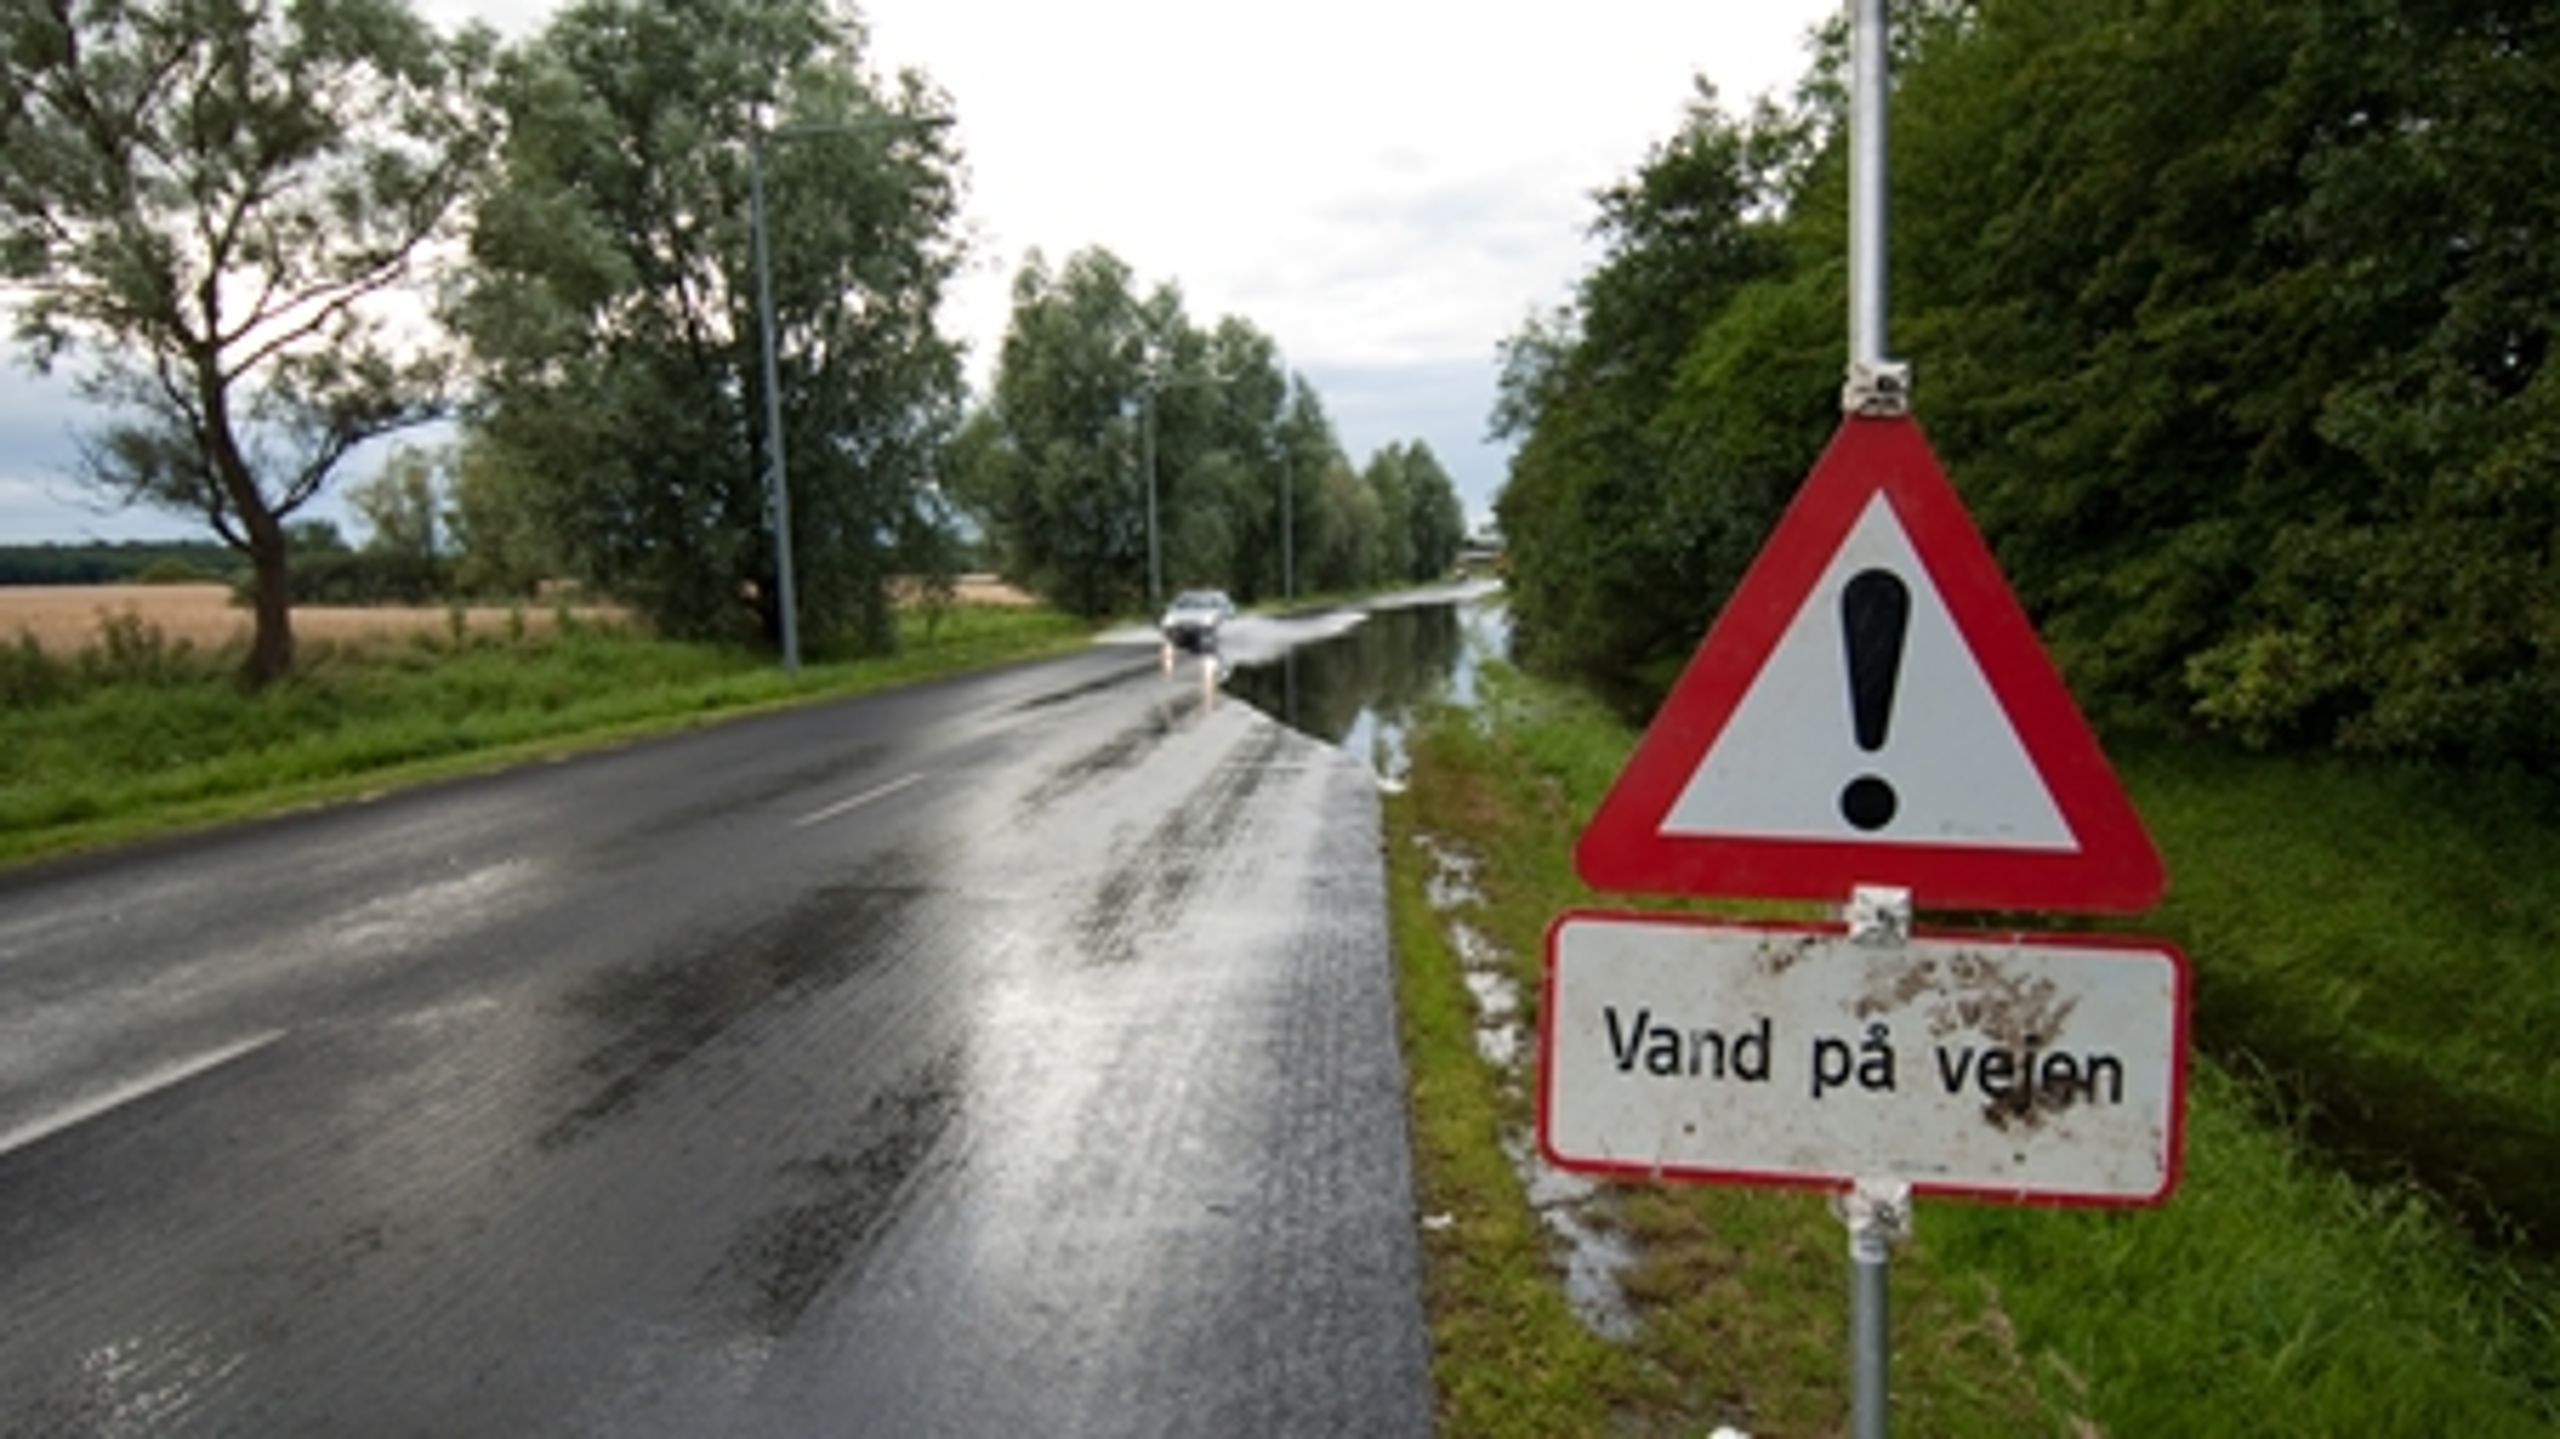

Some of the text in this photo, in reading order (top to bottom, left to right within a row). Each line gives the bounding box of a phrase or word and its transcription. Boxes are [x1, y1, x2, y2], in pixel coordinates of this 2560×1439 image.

[1604, 1006, 2123, 1112] Vand på vejen
